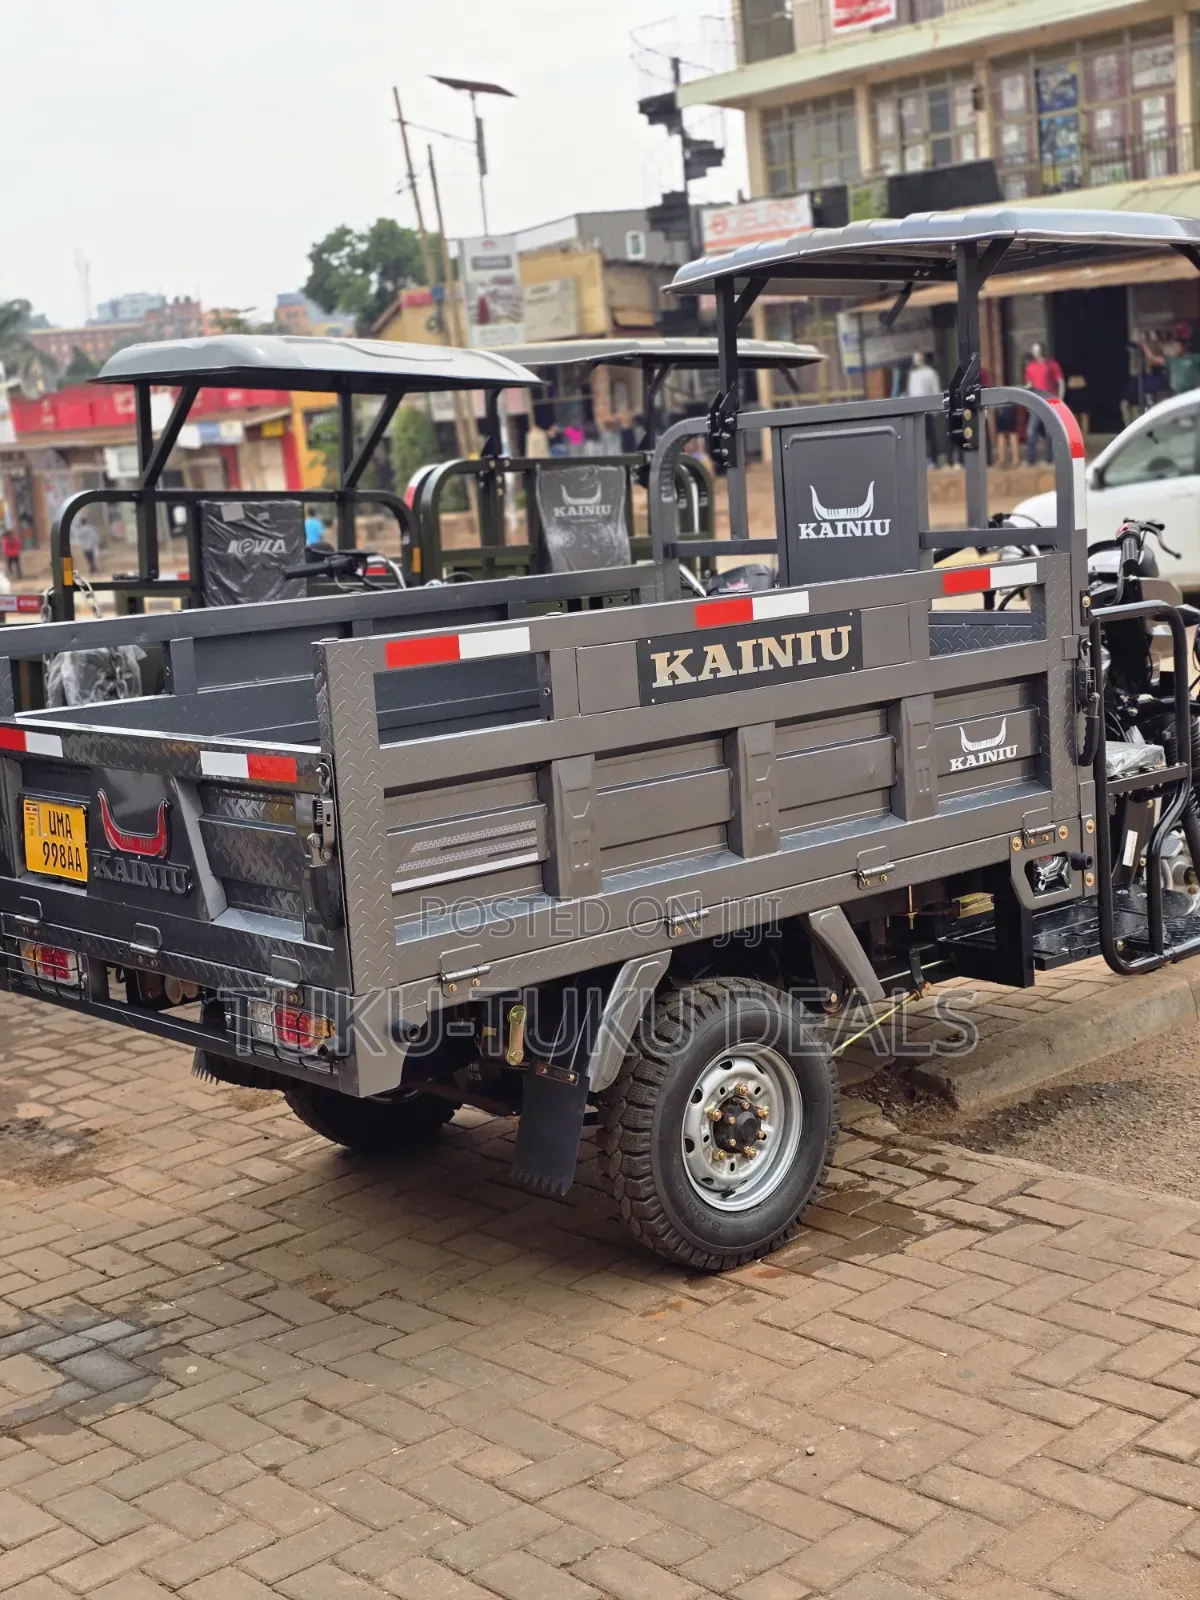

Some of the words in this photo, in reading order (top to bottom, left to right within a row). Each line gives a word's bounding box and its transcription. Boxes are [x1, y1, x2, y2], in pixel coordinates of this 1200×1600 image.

[553, 504, 612, 517] KAINIU
[798, 518, 892, 540] KAINIU
[650, 625, 853, 689] KAINIU
[949, 744, 1019, 773] KAINIU
[48, 810, 73, 840] UMA
[42, 840, 83, 873] 998AA
[92, 854, 190, 894] KAINIU
